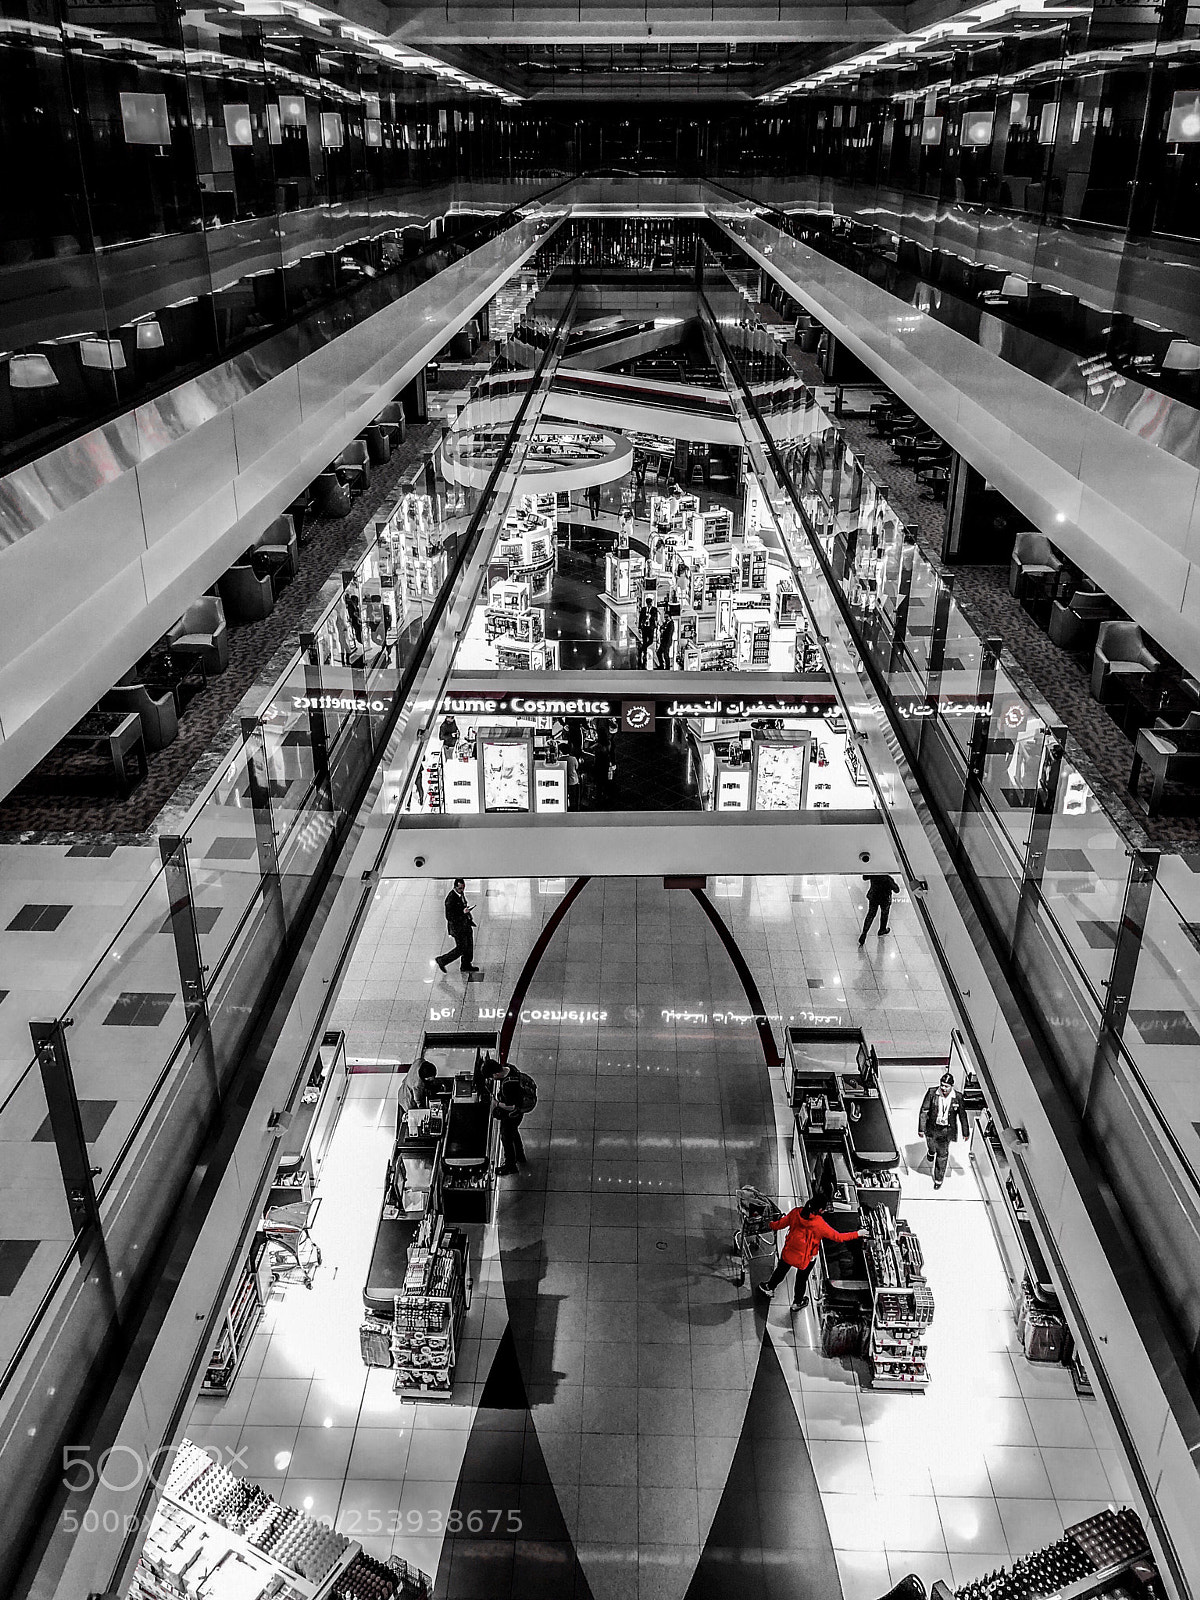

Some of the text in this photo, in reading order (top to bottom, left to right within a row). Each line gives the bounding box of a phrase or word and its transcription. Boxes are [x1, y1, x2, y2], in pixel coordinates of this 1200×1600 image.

[443, 697, 610, 713] fume Cosmetics
[667, 701, 721, 715] التجميل
